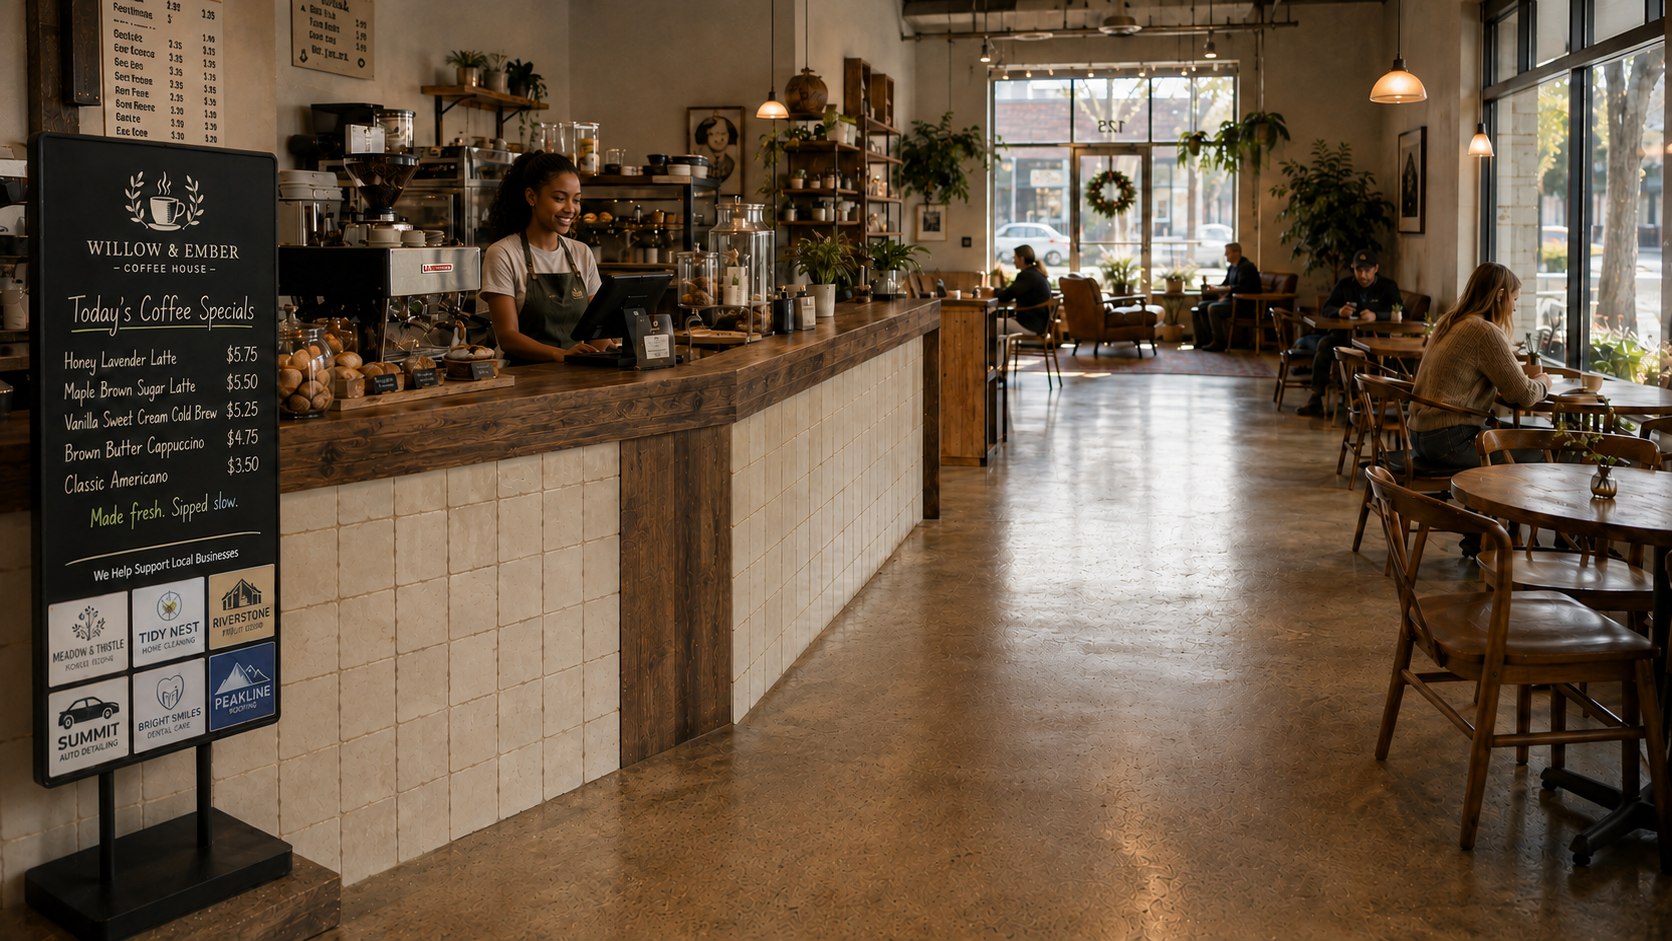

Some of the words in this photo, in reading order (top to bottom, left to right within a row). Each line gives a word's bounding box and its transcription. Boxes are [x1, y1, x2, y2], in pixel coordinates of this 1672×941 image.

[87, 240, 162, 257] WILLOW
[168, 244, 179, 258] &
[185, 244, 240, 260] EMBER
[124, 264, 166, 273] COFFEE
[172, 264, 207, 274] HOUSE
[68, 294, 132, 337] Today's
[140, 294, 192, 322] Coffee
[200, 294, 255, 331] Specials
[64, 351, 97, 377] Honey
[101, 349, 147, 369] Lavender
[150, 348, 177, 366] Latte
[226, 344, 258, 365] $5.75
[64, 380, 95, 407] Maple
[100, 380, 133, 398] Brown
[137, 378, 166, 403] Sugar
[170, 377, 196, 394] Latte
[226, 372, 259, 393] $5.50
[64, 412, 99, 431] Vanilla
[102, 410, 133, 429] Sweet
[138, 408, 168, 426] Cream
[172, 404, 192, 423] Cold
[194, 404, 218, 421] Brew
[226, 400, 259, 420] $5.25
[64, 443, 101, 462] Brown
[106, 440, 143, 459] Butter
[147, 436, 205, 459] Cappuccino
[226, 428, 259, 448] $4.75
[64, 473, 105, 495] Classic
[110, 470, 169, 489] Americano
[227, 456, 260, 476] $3.50
[90, 504, 124, 528] Made
[130, 500, 165, 530] fresh.
[172, 493, 209, 523] Sipped
[214, 490, 239, 510] slow.
[94, 570, 110, 582] We
[112, 564, 133, 579] Help
[134, 558, 170, 576] Support
[172, 554, 194, 569] Local
[196, 548, 239, 565] Businesses
[213, 606, 270, 629] RIVERSTONE
[139, 628, 167, 644] TIDY
[170, 622, 200, 638] NEST
[164, 637, 196, 649] CLEANING
[52, 647, 88, 663] MEADOW
[96, 639, 124, 654] THISTLE
[215, 684, 271, 710] PEAKLINE
[138, 716, 170, 732] BRIGHT
[172, 708, 202, 723] SMILES
[148, 727, 172, 739] DENTAL
[58, 722, 120, 751] SUMMIT
[60, 750, 79, 762] AUTO
[82, 739, 119, 755] DETAILING
